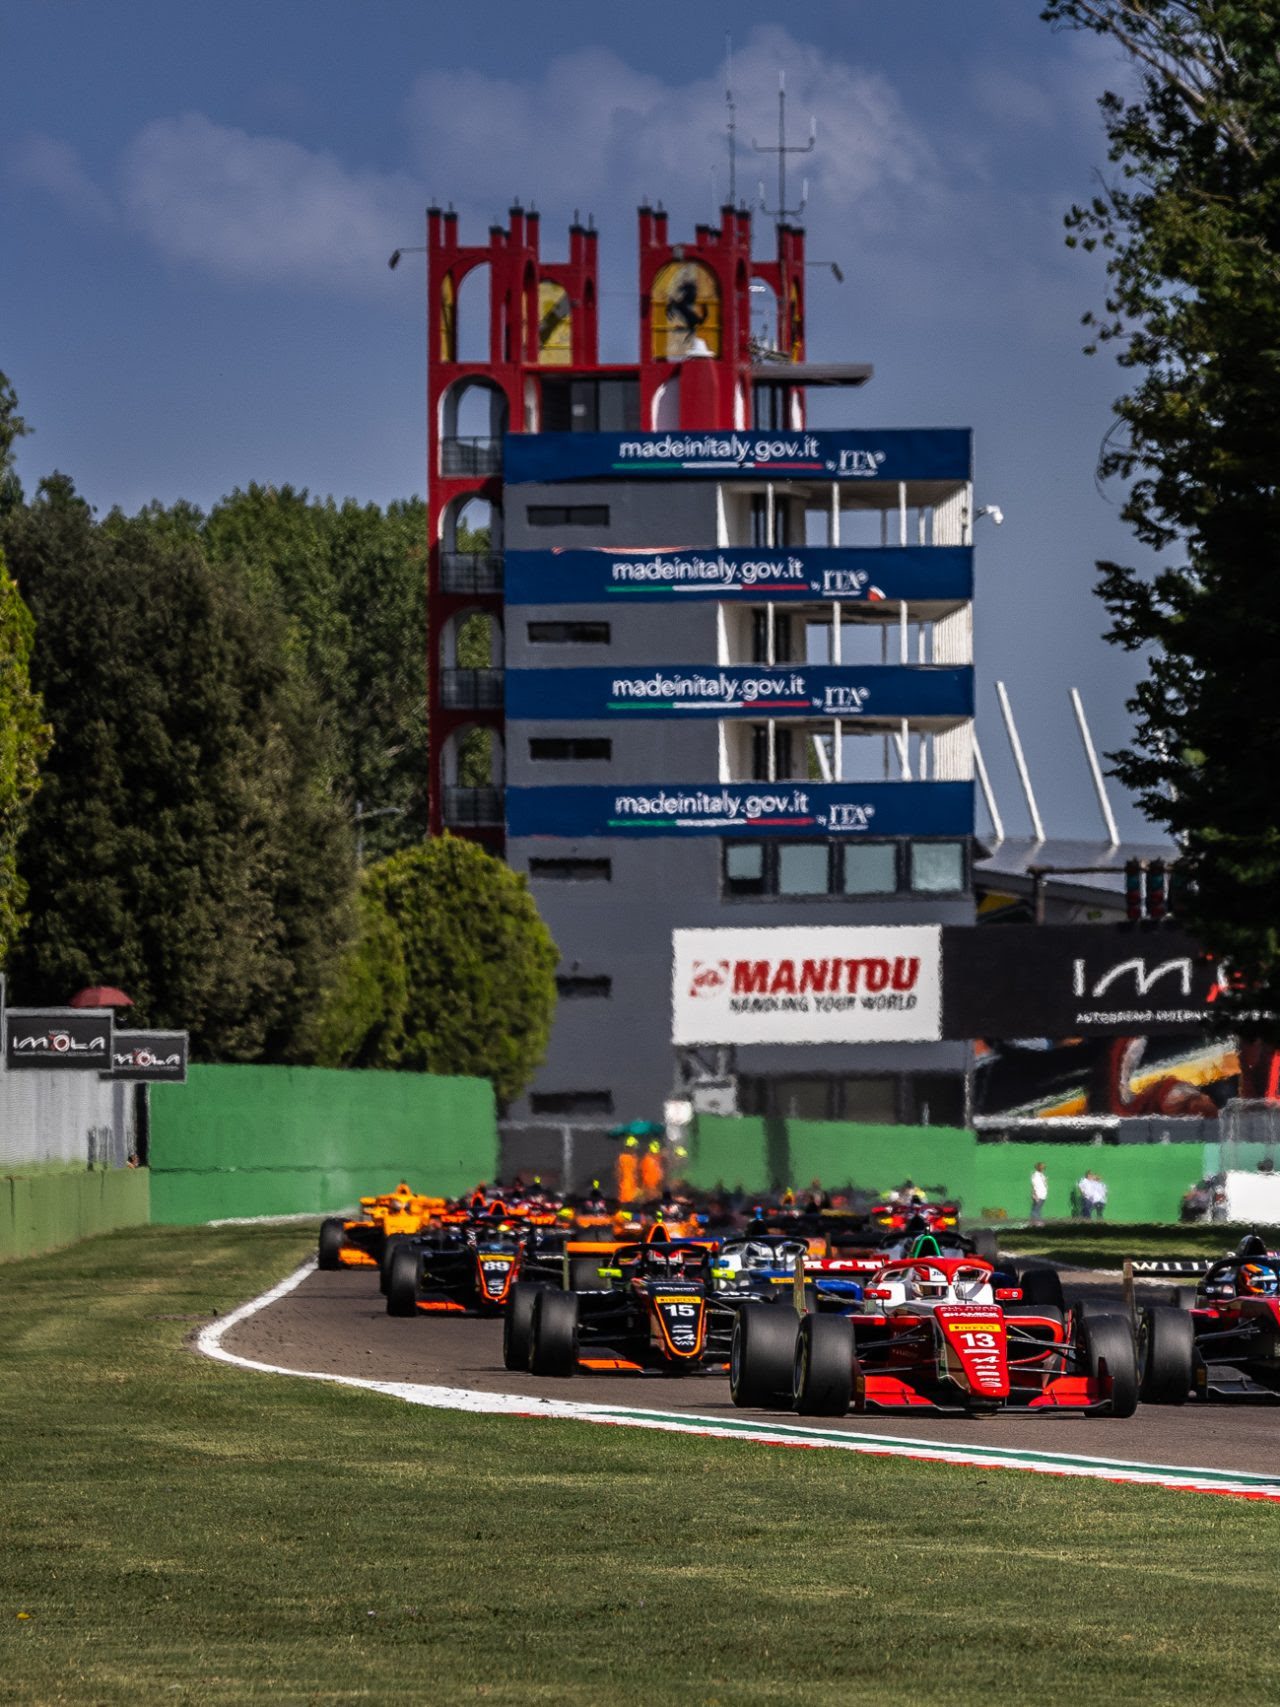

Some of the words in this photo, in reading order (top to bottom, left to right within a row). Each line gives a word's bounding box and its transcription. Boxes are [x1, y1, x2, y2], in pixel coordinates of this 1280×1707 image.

[619, 434, 819, 463] madeinitaly.gov.it
[612, 556, 804, 585] madeinitaly.gov.it
[612, 673, 806, 700] madeinitaly.gov.it
[614, 790, 809, 819] madeinitaly.gov.it
[733, 957, 919, 994] MANITOU
[814, 996, 857, 1013] YOUR
[861, 993, 918, 1012] WORLD
[483, 1261, 510, 1271] 89
[664, 1304, 695, 1317] 15
[960, 1333, 996, 1347] 13
